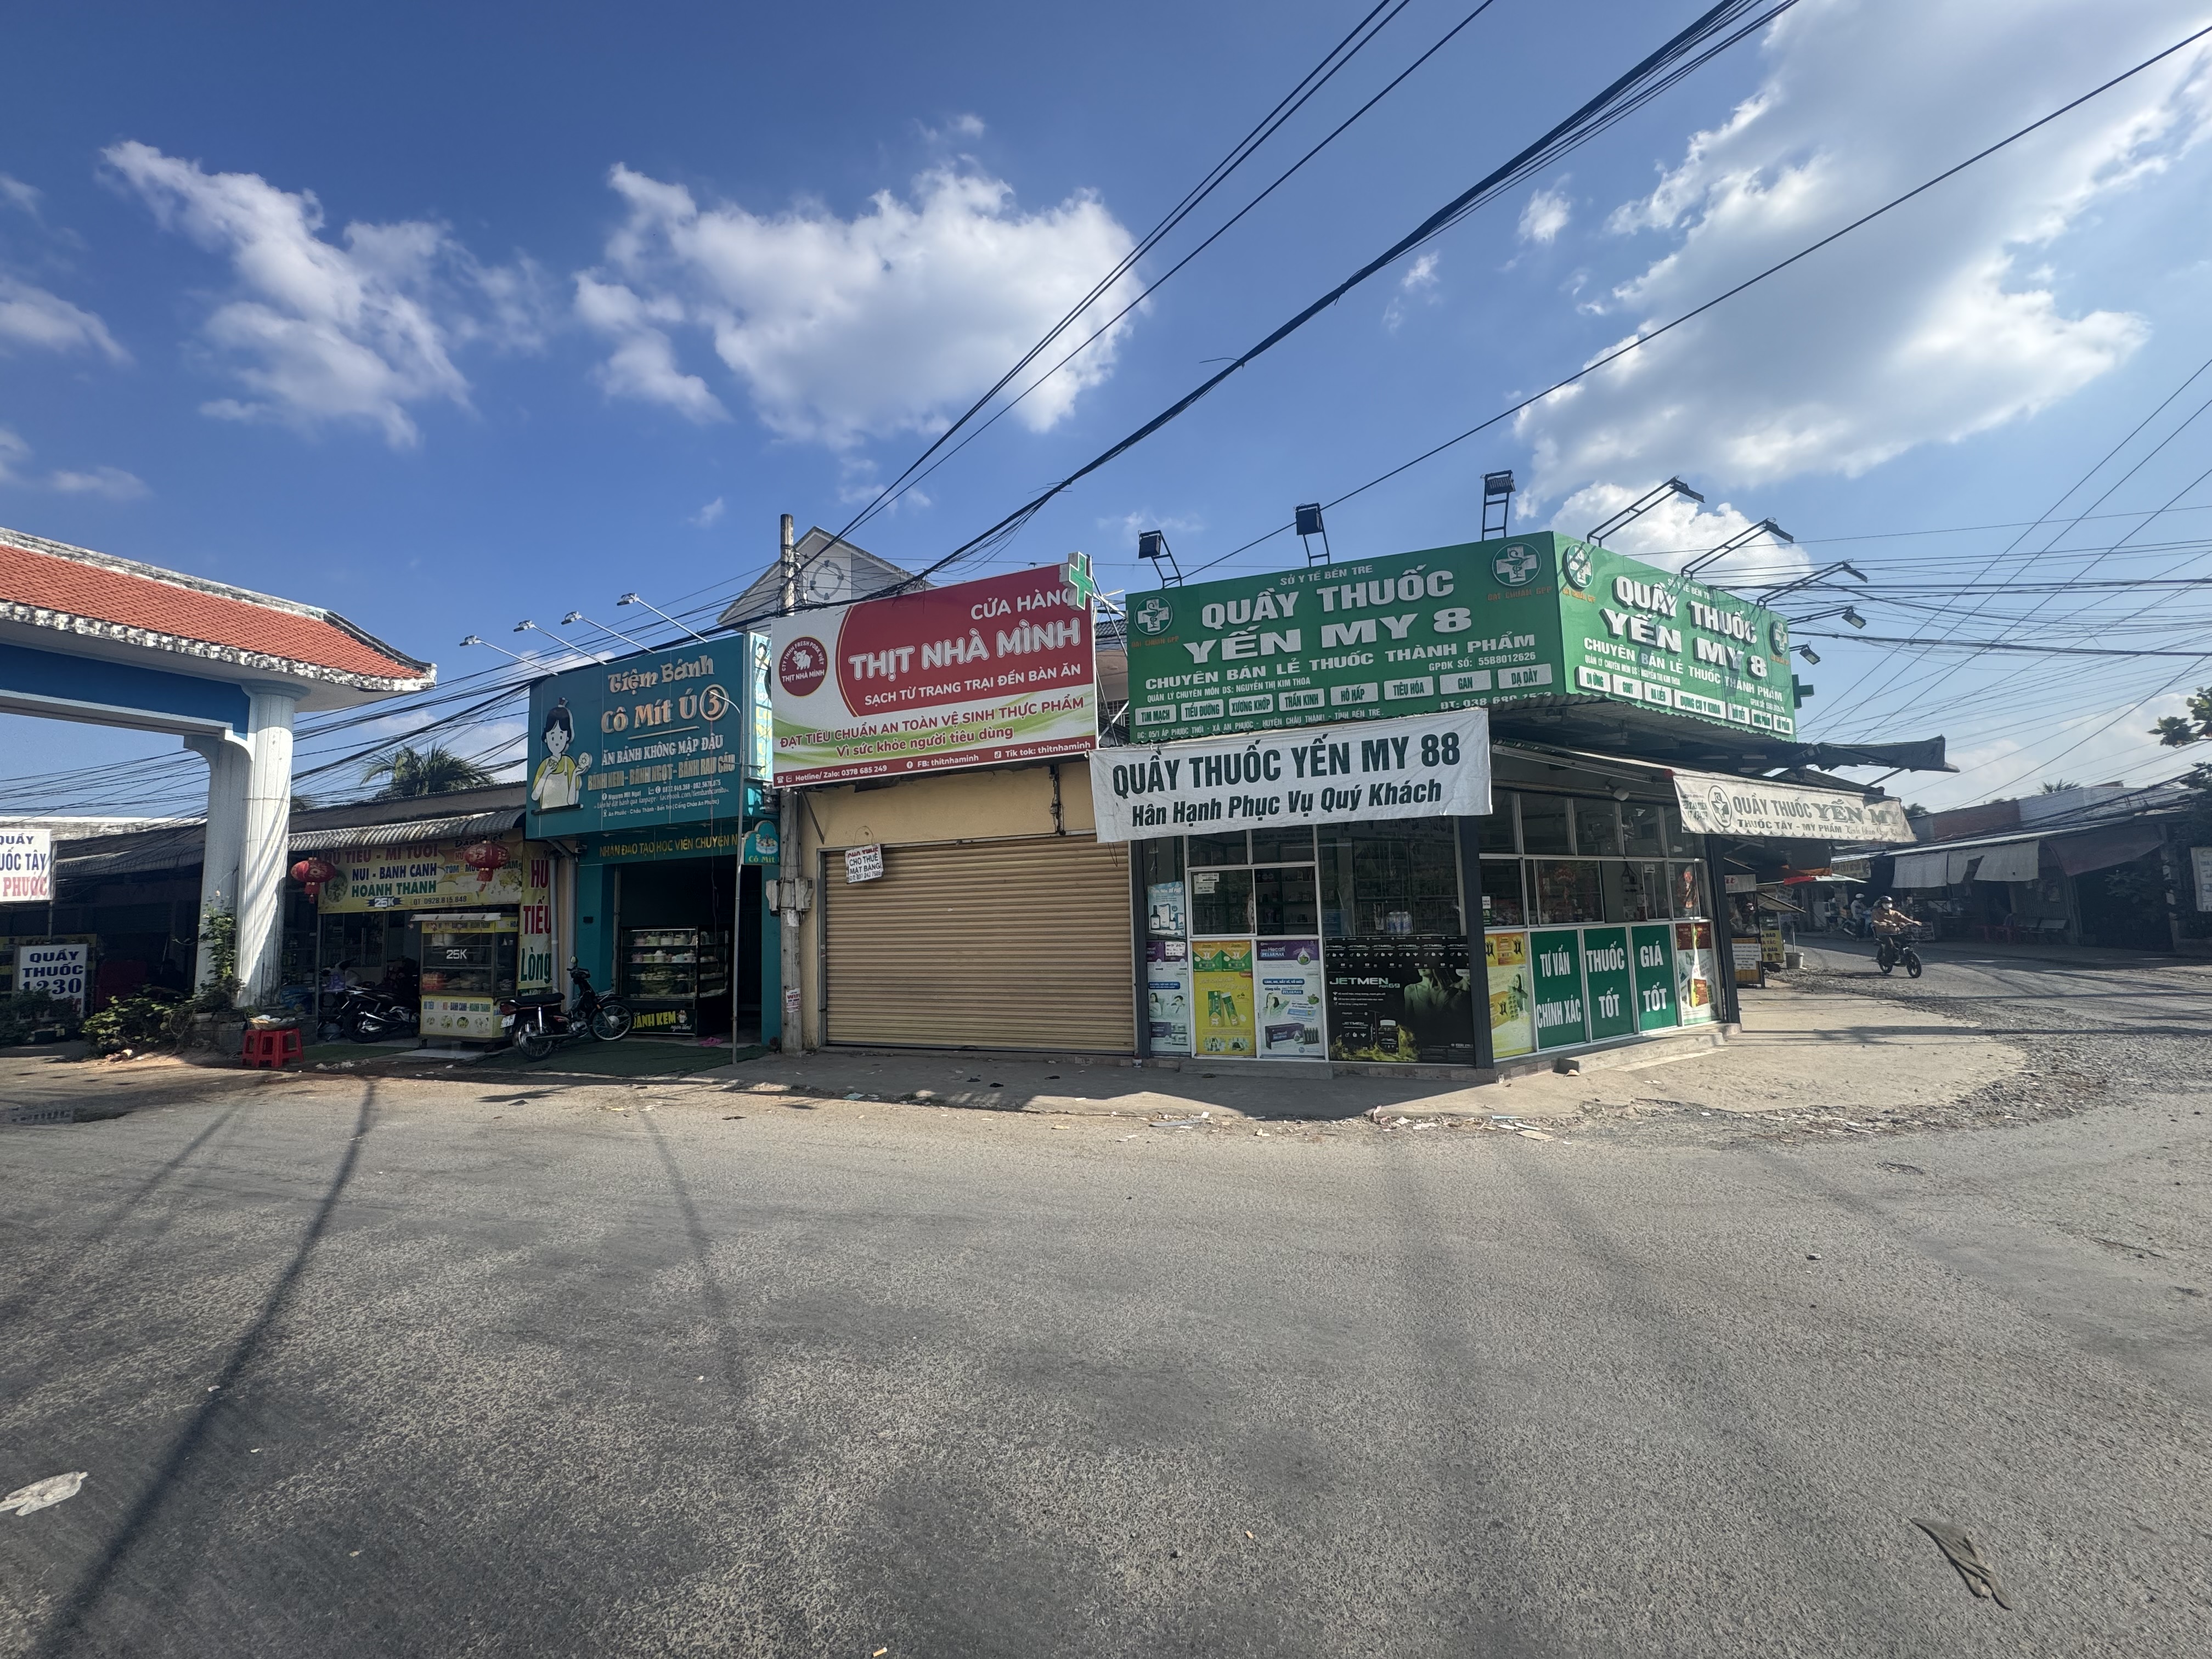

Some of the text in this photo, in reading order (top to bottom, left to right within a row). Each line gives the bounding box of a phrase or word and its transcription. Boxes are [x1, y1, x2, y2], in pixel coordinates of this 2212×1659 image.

[1299, 575, 1305, 584] Y
[1308, 571, 1321, 582] TẾ
[1324, 567, 1347, 579] BẾN
[1352, 565, 1373, 575] TRE
[970, 597, 1011, 621] CỬA
[1202, 564, 1454, 630] QUẦY THUỐC
[1183, 607, 1472, 664] YẾN MY 8
[1690, 601, 1757, 644] THUỐC
[783, 646, 795, 661] TNHH
[794, 640, 810, 649] FRESH
[809, 641, 821, 653] PORK
[849, 617, 1081, 682] THỊT NHÀ MÌNH
[1604, 608, 1767, 678] YẾN MY 8
[608, 655, 715, 695] Tiệm Bánh
[795, 671, 809, 680] NHÀ
[809, 669, 825, 678] MÌNH
[1146, 631, 1535, 690] CHUYÊN BÁN LẺ THUỐC THÀNH PHẨM
[1457, 656, 1472, 668] SỐ:
[1584, 637, 1635, 662] CHUYÊN
[1641, 653, 1666, 670] BÁN
[1669, 658, 1684, 675] LẺ
[1688, 664, 1722, 684] THUỐC
[1724, 675, 1755, 694] THÀNH
[865, 662, 1081, 707] SẠCH TỪ TRANG TRẠI ĐẾN BÀN ĂN
[1147, 676, 1311, 703] QUẢN LÝ CHUYÊN MÔN DS: NGUYỄN THỊ KIM THOA
[1393, 681, 1425, 697] TIÊU HÓA
[1458, 676, 1473, 690] GAN
[601, 687, 722, 733] Cô Mít Ú 3
[780, 693, 1085, 749] ĐẠT TIÊU CHUẨN AN TOÀN VỆ SINH THỰC PHẨM
[1141, 709, 1170, 724] TIM MẠCH
[601, 749, 616, 766] ĂN
[617, 745, 642, 764] BÁNH
[644, 741, 678, 760] KHÔNG
[678, 736, 700, 757] MẬP
[836, 726, 1014, 757] Vì sức khỏe người tiêu dùng
[795, 772, 822, 782] Hotline/
[841, 768, 859, 777] 0378
[860, 766, 873, 774] 685
[874, 764, 888, 773] 249
[917, 758, 929, 768] FB:
[1005, 749, 1018, 758] Tik
[1019, 746, 1037, 757] tok:
[1037, 740, 1091, 754] thitnhaminh
[1113, 731, 1460, 799] QUẦY THUỐC YẾN MY 88
[1131, 778, 1442, 828] Hân Hạnh Phục Vụ Quý Khách
[1733, 792, 1768, 816] QUẦY
[1770, 797, 1813, 819] THUỐC
[1810, 798, 1864, 825] YẾN
[1737, 818, 1773, 829] THUỐC
[1774, 821, 1793, 830] TÂY
[352, 868, 369, 881] NUI
[409, 862, 437, 878] CANH
[849, 857, 862, 866] CHO
[352, 881, 393, 898] HOÀNH
[374, 897, 395, 908] 25K
[523, 895, 551, 935] TIẾU
[30, 948, 79, 963] QUẦY
[446, 949, 468, 960] 25K
[520, 947, 552, 984] Lòng
[1540, 944, 1571, 978] TƯ VẤN
[1586, 940, 1625, 974] THUỐC
[1640, 940, 1663, 968] GIÁ
[22, 962, 84, 978] THUỐC
[1329, 977, 1389, 986] JETMEN
[1536, 994, 1581, 1030] CHÍNH XÁC
[1598, 987, 1620, 1019] TỐT
[1643, 981, 1667, 1013] TỐT
[656, 1011, 676, 1026] KEM
